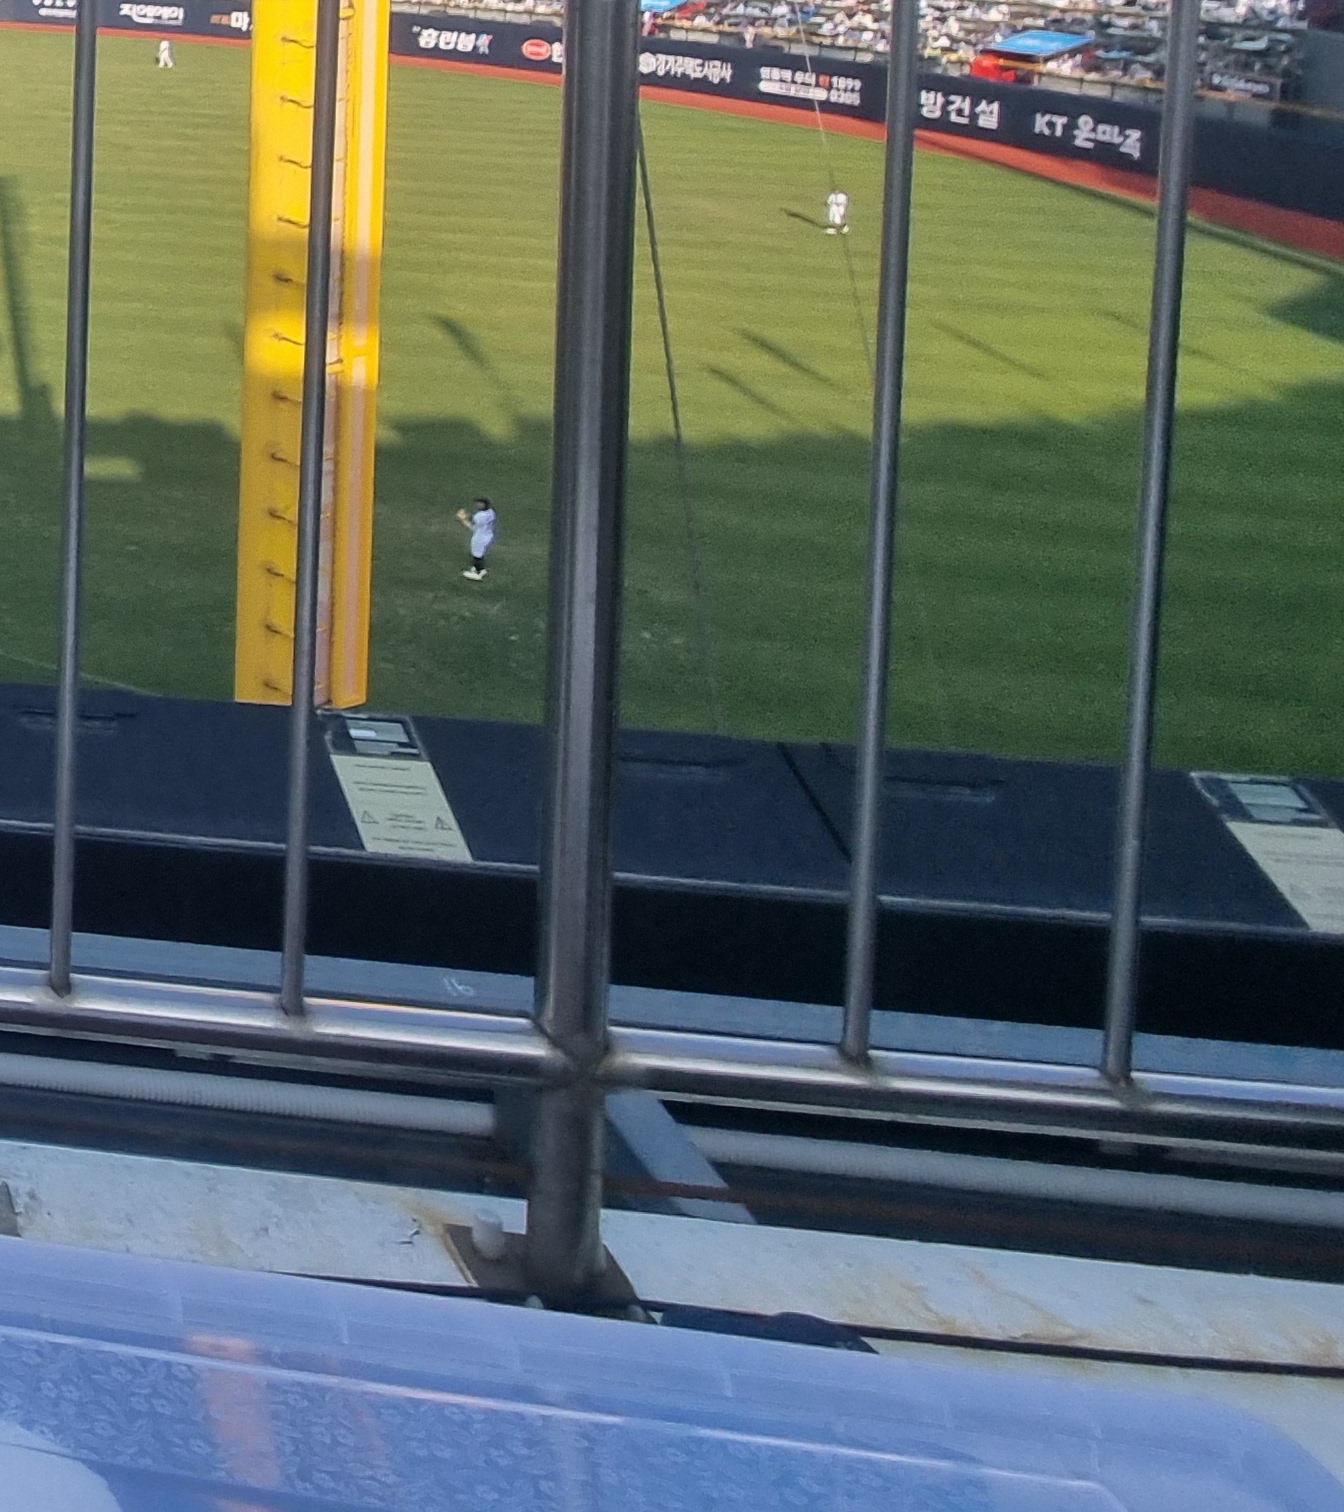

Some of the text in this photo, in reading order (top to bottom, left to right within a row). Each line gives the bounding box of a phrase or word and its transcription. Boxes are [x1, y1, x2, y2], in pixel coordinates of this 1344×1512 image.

[656, 53, 732, 84] 경기주택도시공사
[920, 89, 1001, 130] 방건설
[1034, 111, 1069, 137] KT
